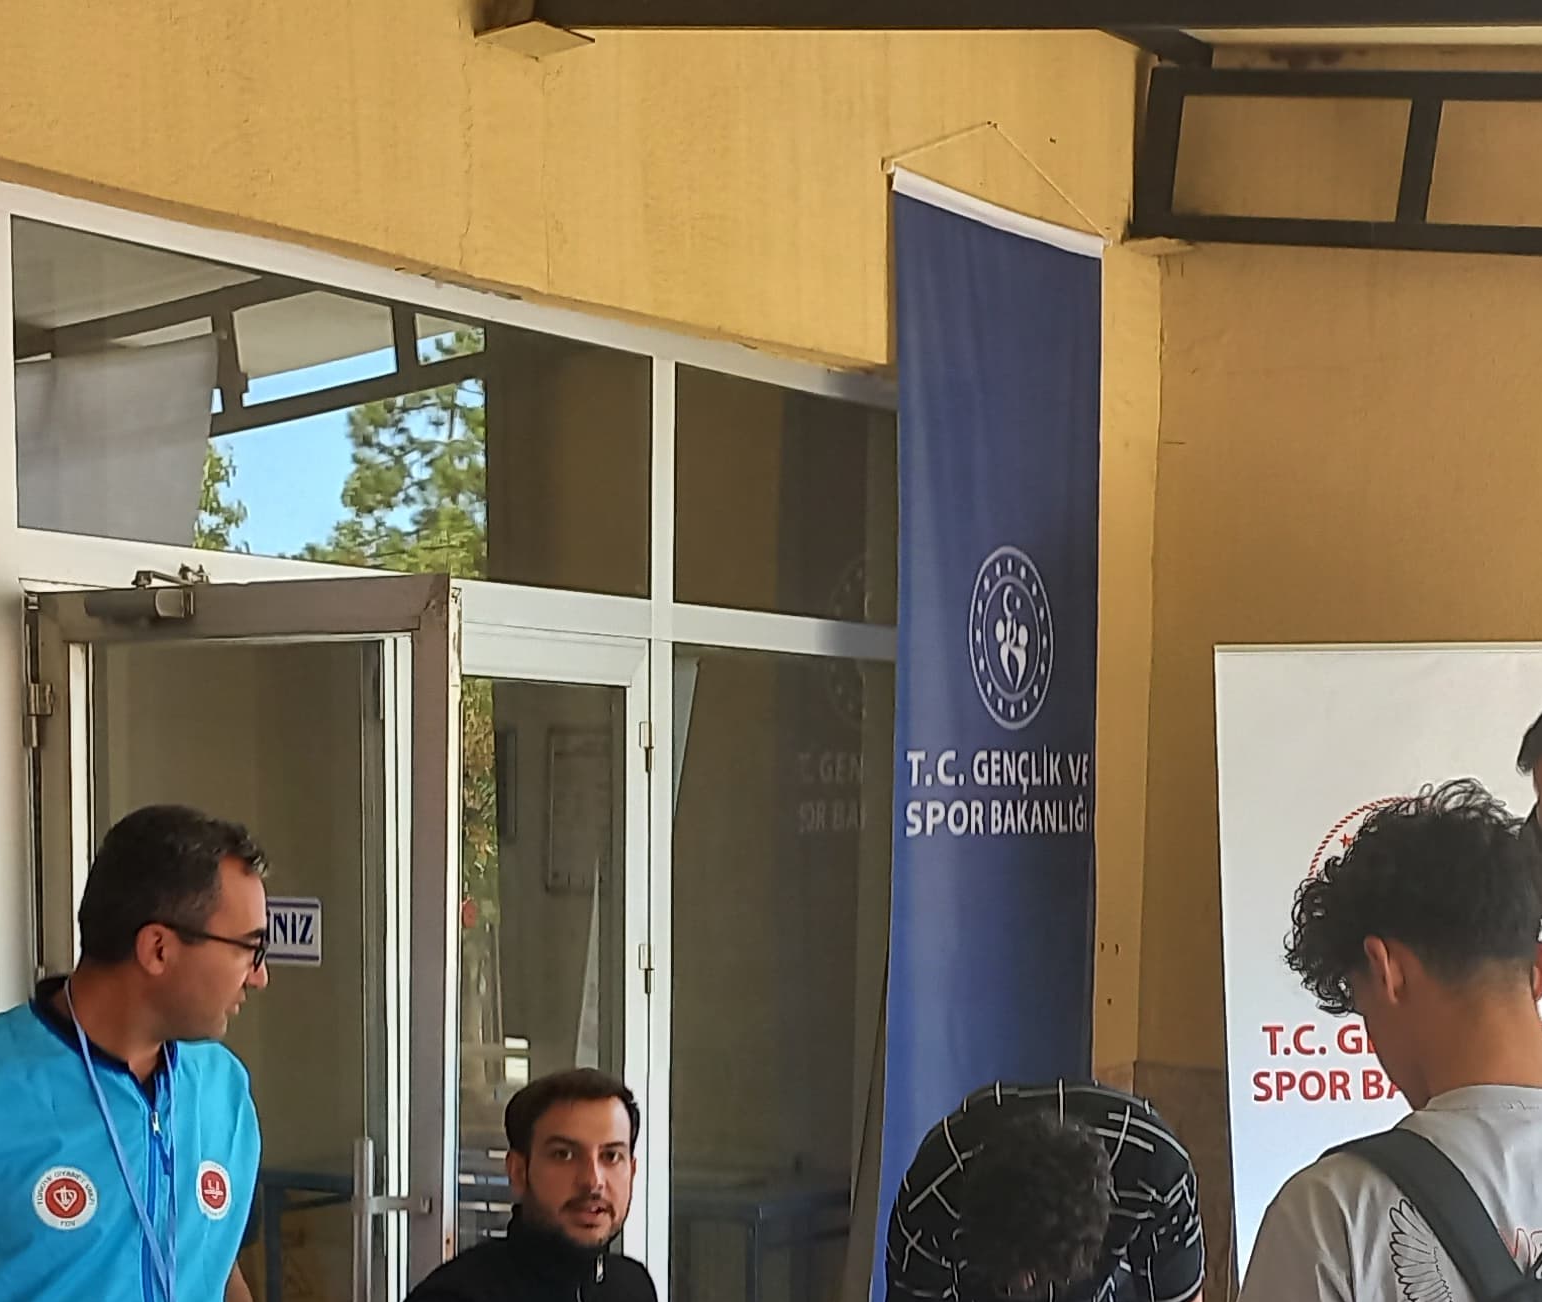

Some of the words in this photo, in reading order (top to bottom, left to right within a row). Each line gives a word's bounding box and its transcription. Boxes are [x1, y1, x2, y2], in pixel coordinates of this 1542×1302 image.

[907, 750, 965, 787] T.C.
[972, 745, 1062, 795] GENÇLİK
[905, 799, 985, 838] SPOR
[1261, 1024, 1327, 1056] T.C.
[1253, 1070, 1351, 1101] SPOR
